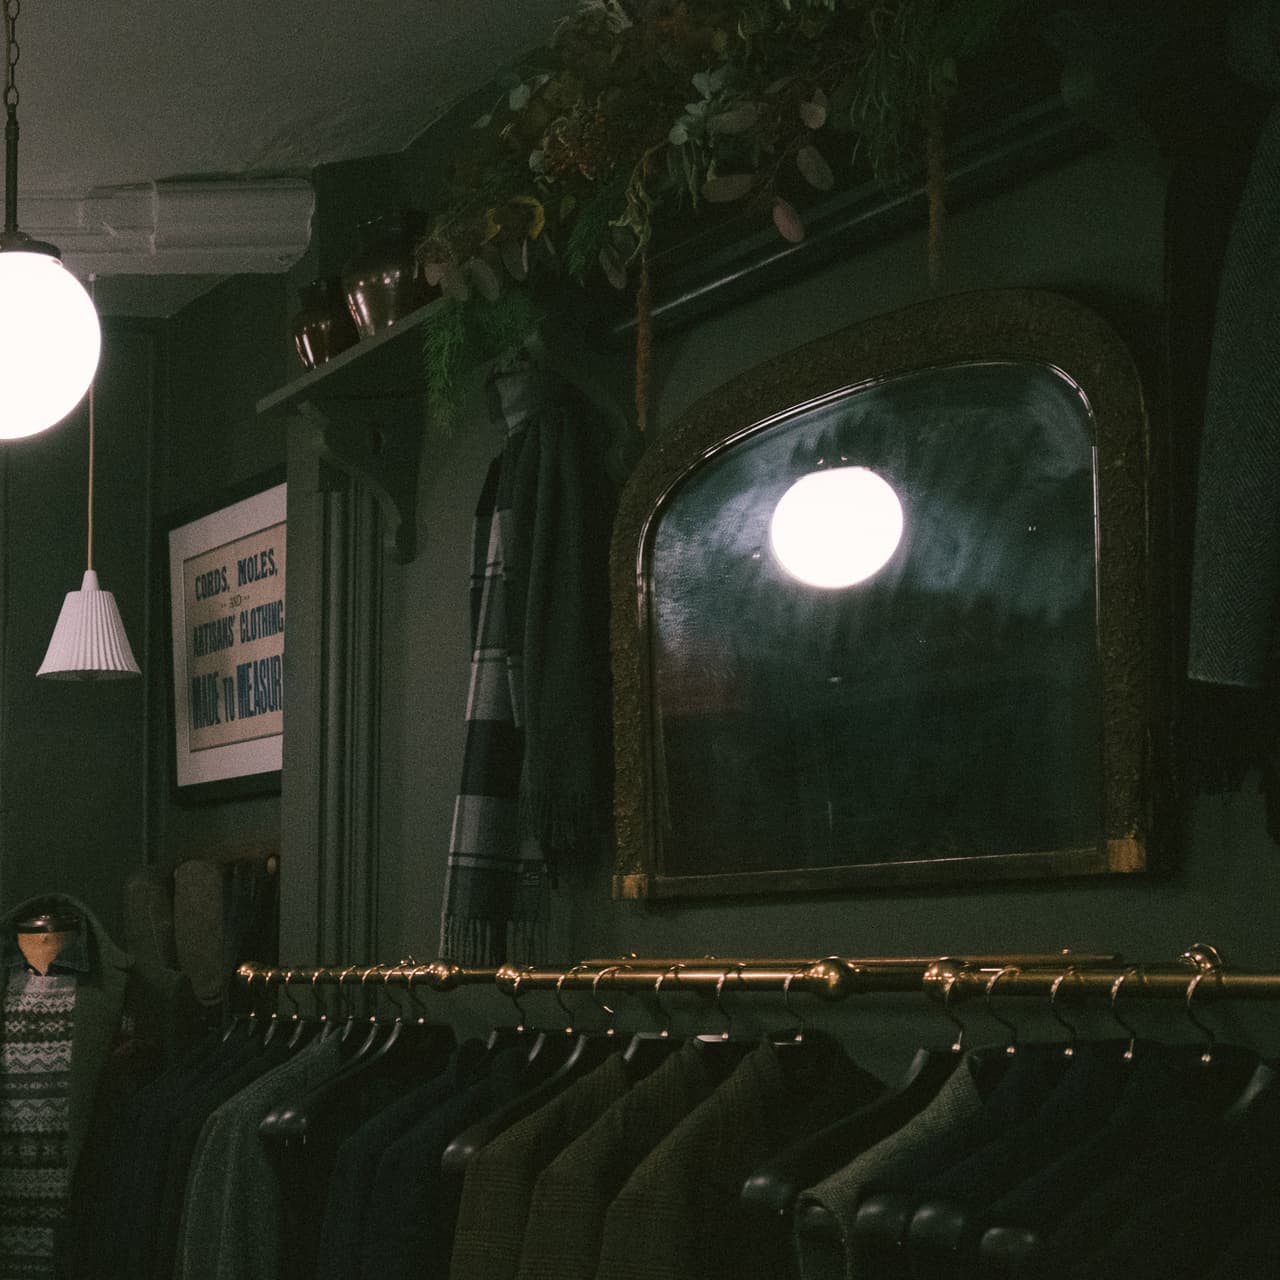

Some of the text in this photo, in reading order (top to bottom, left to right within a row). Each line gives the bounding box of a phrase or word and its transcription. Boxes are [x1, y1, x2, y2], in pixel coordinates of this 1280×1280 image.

[240, 599, 284, 644] CLOTHING
[192, 654, 283, 730] MADE TO MEASUR
